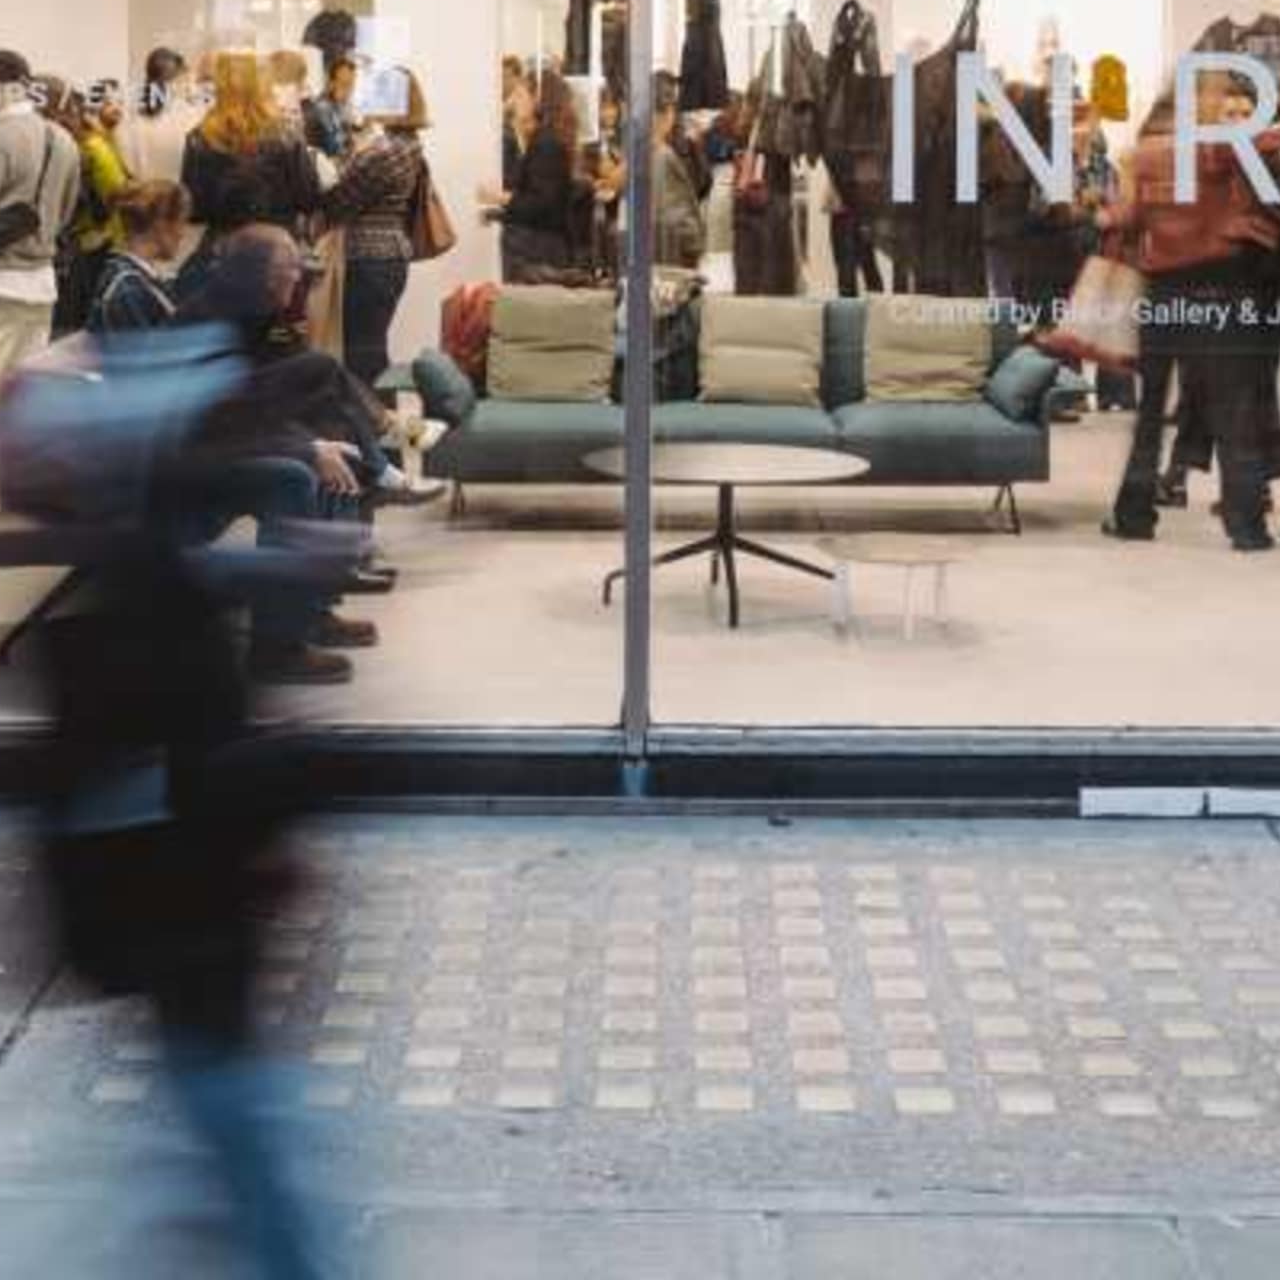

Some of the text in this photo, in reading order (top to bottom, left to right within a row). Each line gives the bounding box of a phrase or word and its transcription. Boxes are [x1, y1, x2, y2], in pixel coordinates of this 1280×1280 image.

[891, 51, 1074, 204] IN
[1010, 297, 1042, 332] by
[1131, 296, 1231, 331] Gallery
[1238, 297, 1259, 325] &
